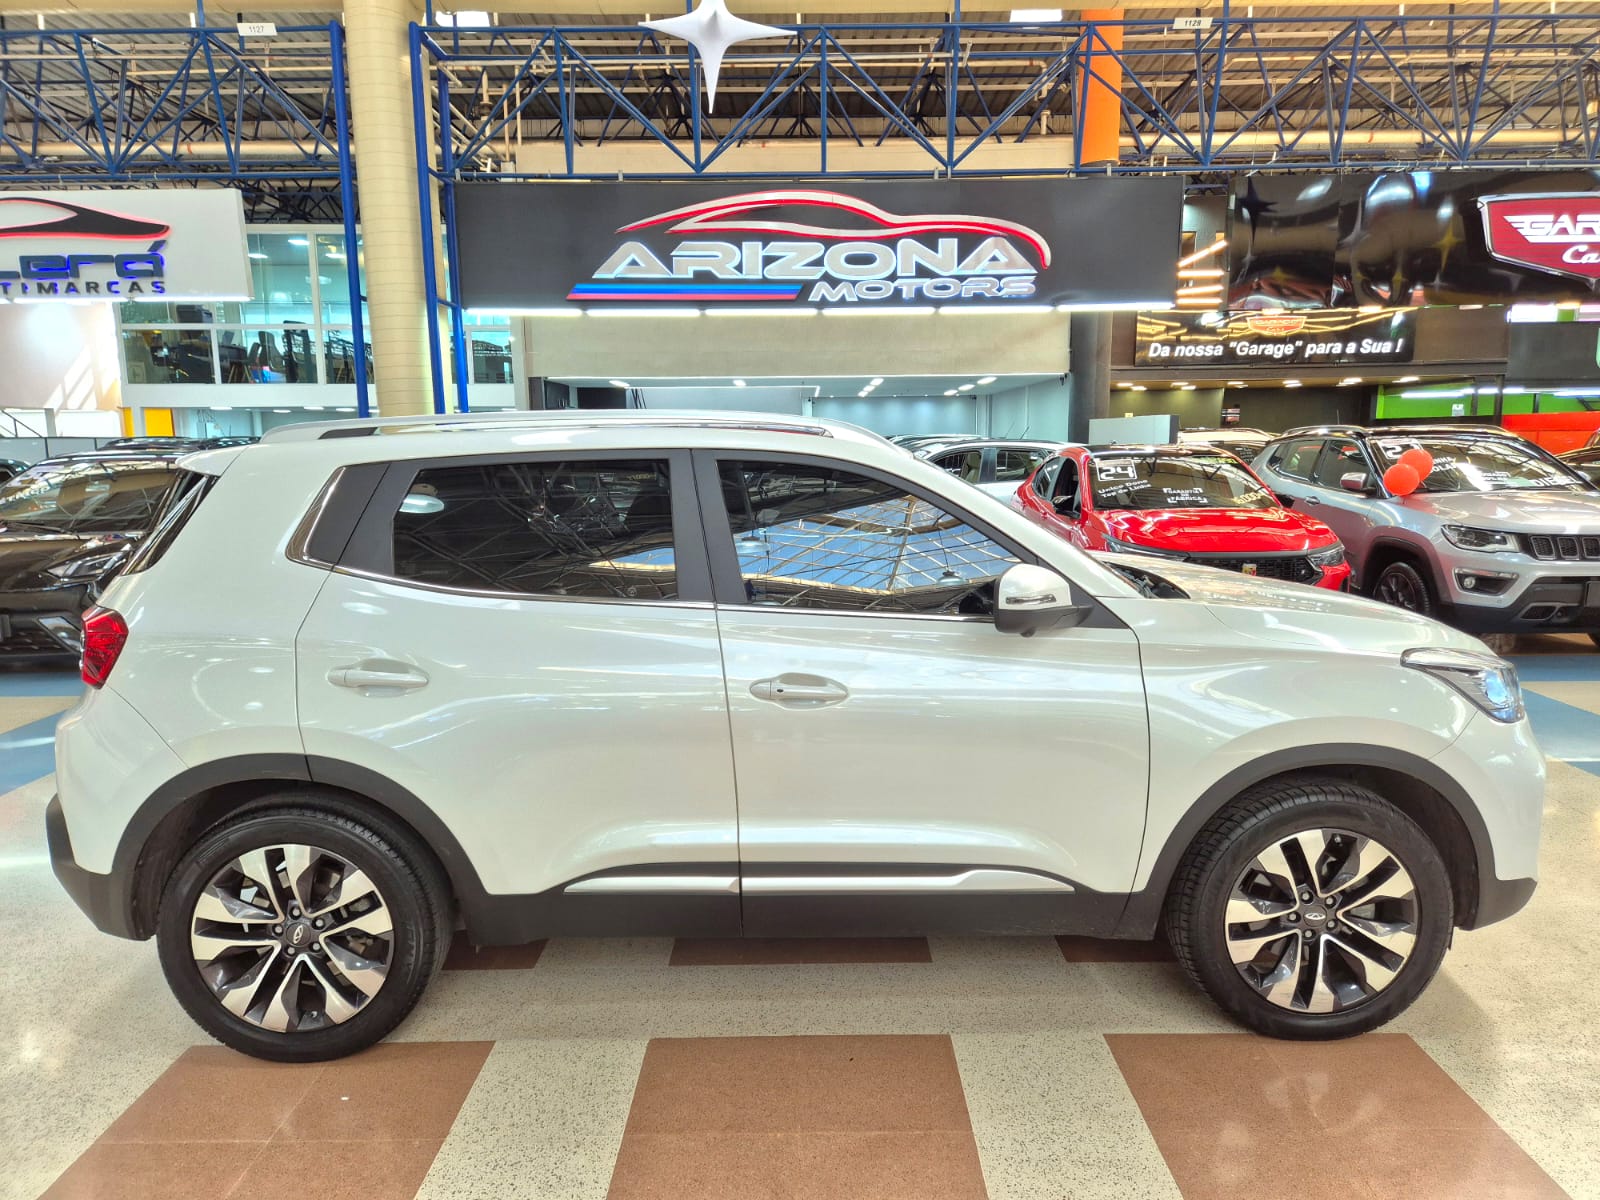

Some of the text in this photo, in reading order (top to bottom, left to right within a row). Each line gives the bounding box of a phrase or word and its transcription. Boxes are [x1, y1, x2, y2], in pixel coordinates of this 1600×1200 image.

[592, 237, 1038, 280] ARIZONA
[808, 274, 1038, 302] MOTORS
[1149, 342, 1171, 358] Da
[1174, 343, 1224, 357] nossa
[1229, 341, 1303, 359] "Garage"
[1305, 342, 1343, 357] para
[1345, 342, 1355, 354] a
[1360, 338, 1393, 354] Sua
[1100, 466, 1134, 480] 24
